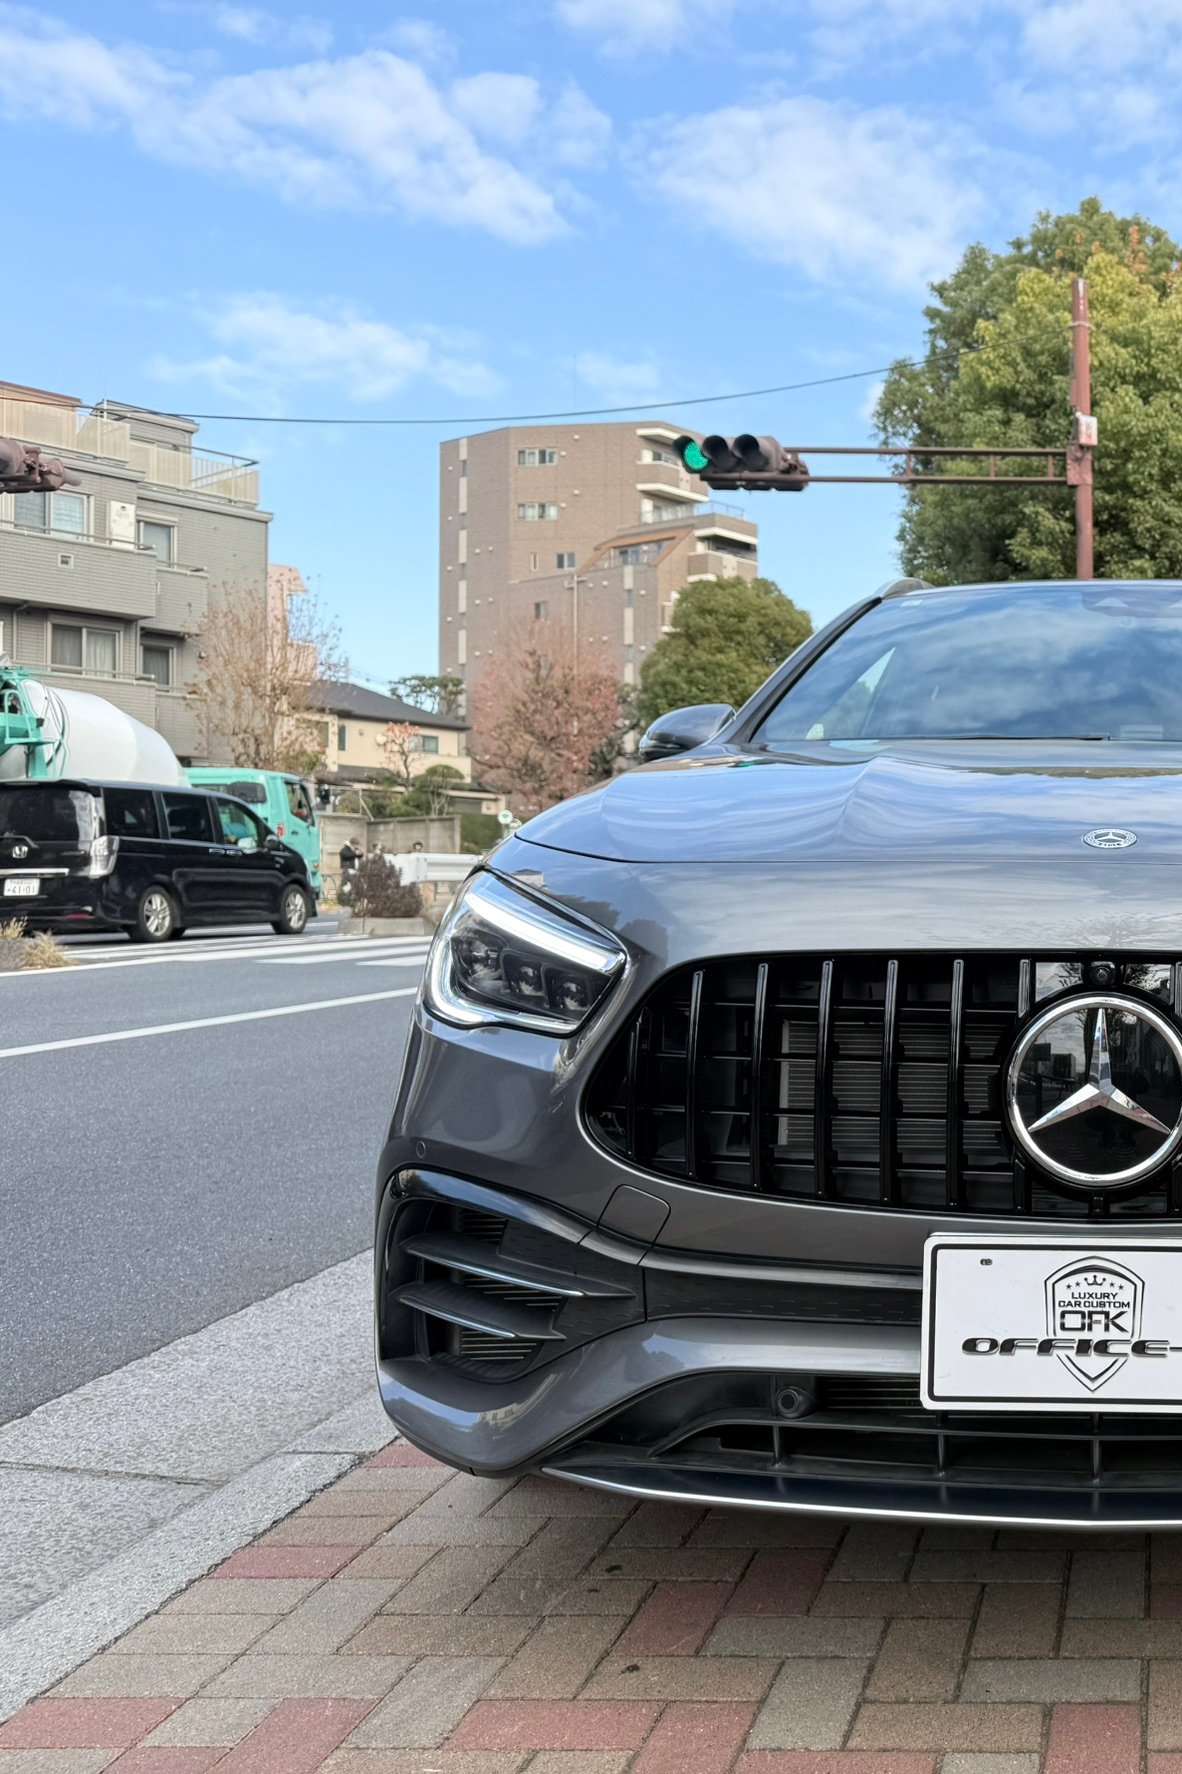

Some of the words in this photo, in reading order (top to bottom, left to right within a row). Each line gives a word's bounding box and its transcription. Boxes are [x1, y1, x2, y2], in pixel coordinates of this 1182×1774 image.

[1071, 1291, 1119, 1300] LUXURY
[1058, 1300, 1082, 1309] CAR
[1083, 1300, 1131, 1309] CUSTOM
